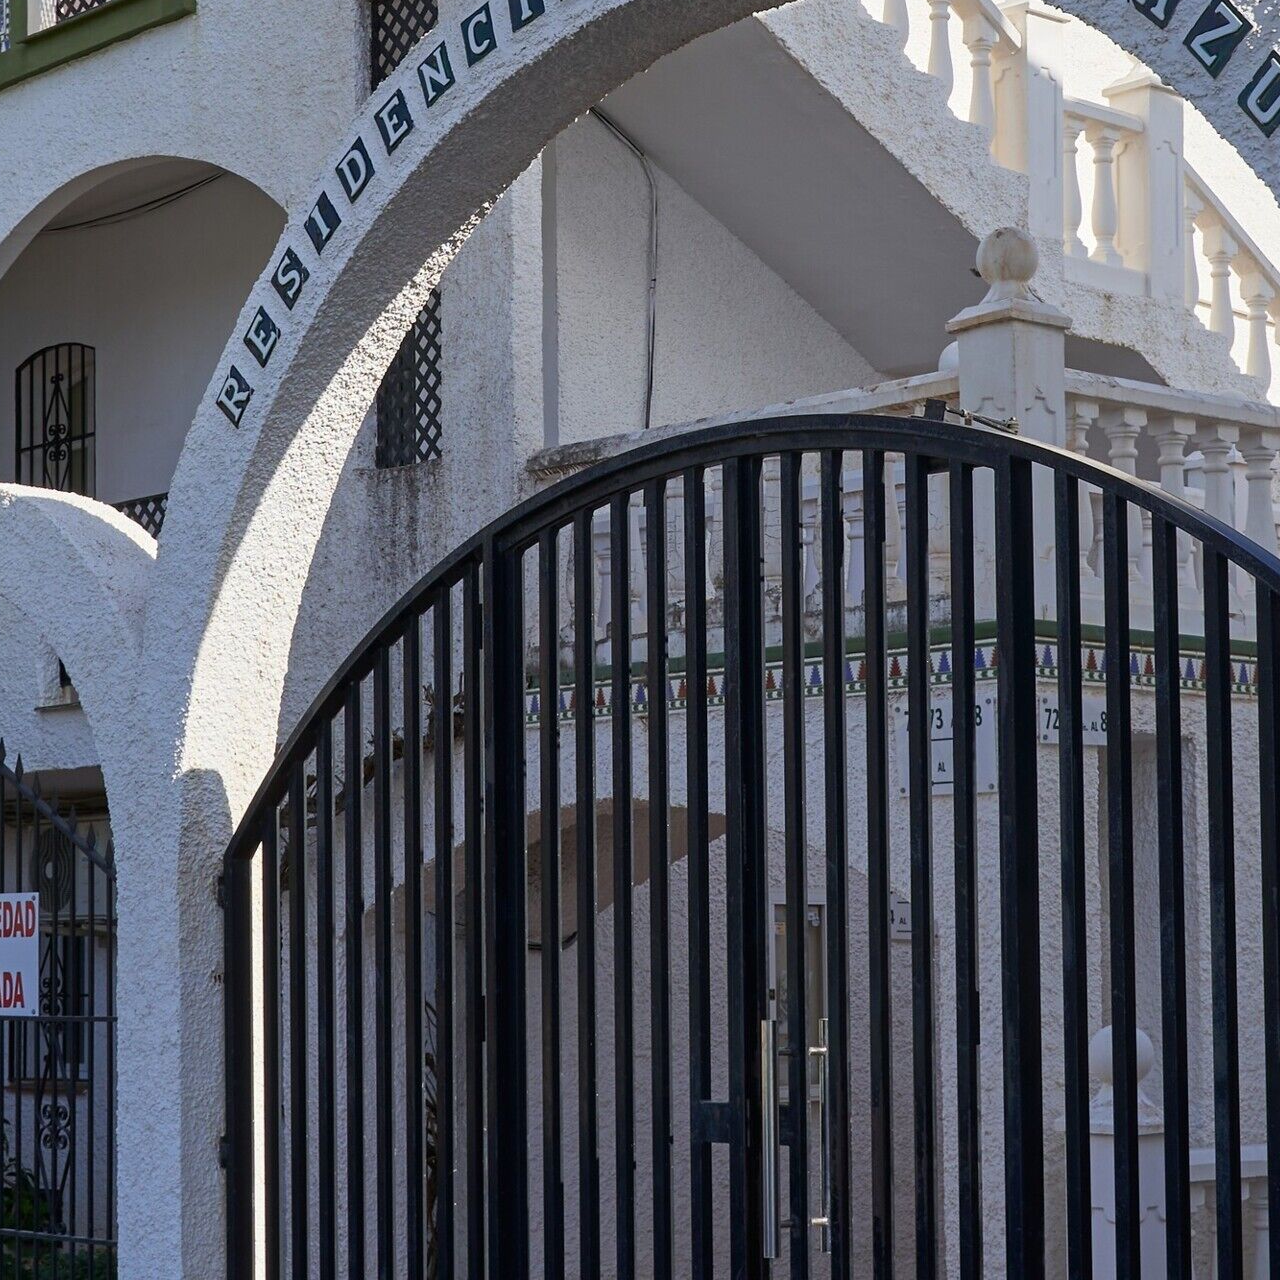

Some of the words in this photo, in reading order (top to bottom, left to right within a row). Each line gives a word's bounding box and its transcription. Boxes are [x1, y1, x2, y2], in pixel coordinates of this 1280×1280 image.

[1044, 708, 1060, 730] 72
[937, 761, 946, 773] AL
[899, 917, 907, 925] AL
